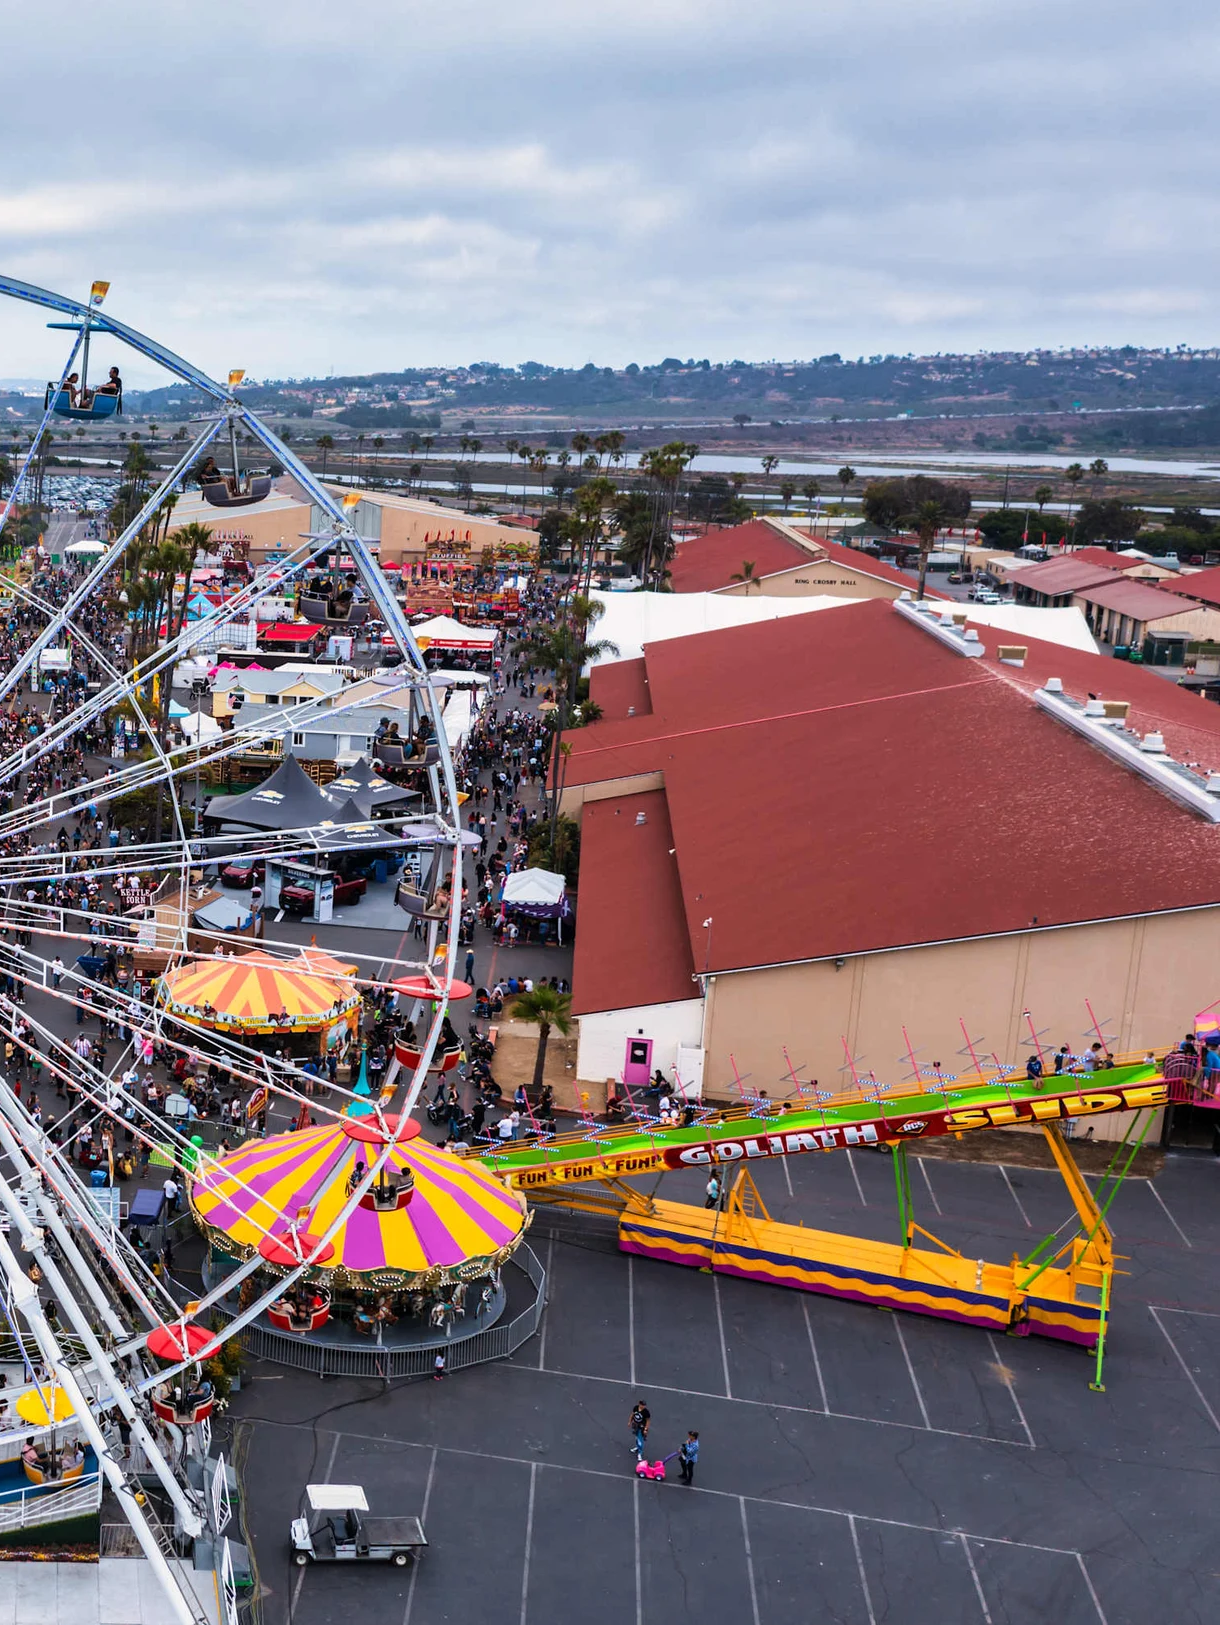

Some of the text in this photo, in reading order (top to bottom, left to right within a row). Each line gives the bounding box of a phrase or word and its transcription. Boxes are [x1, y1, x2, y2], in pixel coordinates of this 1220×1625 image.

[813, 578, 837, 586] CROSBY
[121, 888, 150, 897] KETTLE
[679, 1085, 1169, 1165] GOLIATH SLIDE
[518, 1155, 656, 1185] FUN FUN FUN!
